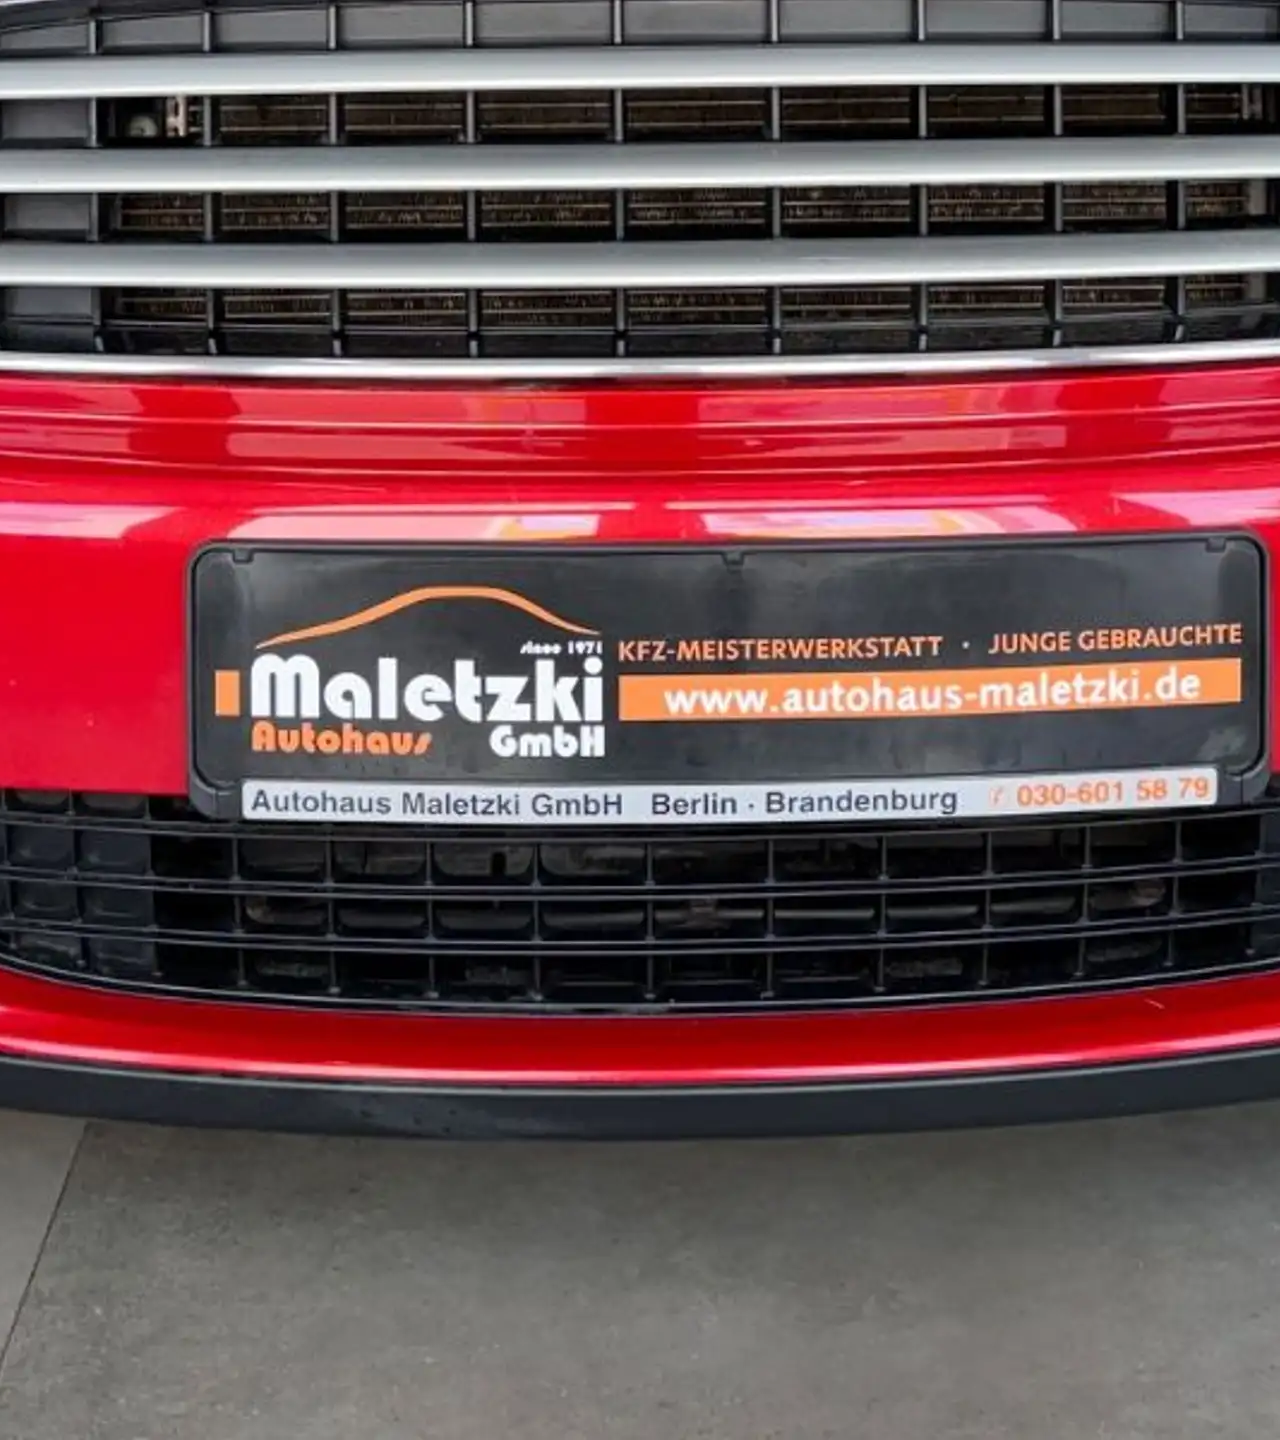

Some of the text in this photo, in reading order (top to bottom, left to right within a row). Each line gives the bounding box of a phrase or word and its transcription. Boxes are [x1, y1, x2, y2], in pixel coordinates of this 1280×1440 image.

[568, 640, 603, 655] 1971
[619, 623, 1242, 662] KFZ-MEISTERWERKSTATT JUNGE GEBRAUCHTE
[251, 653, 603, 723] Maletzki
[664, 667, 1201, 715] www.autohaus-maletzki.de
[251, 721, 606, 758] Autohaus GmbH
[251, 776, 1210, 817] Autohaus Maletzki GmbH Berlin Brandenburg 030-601 58 79
